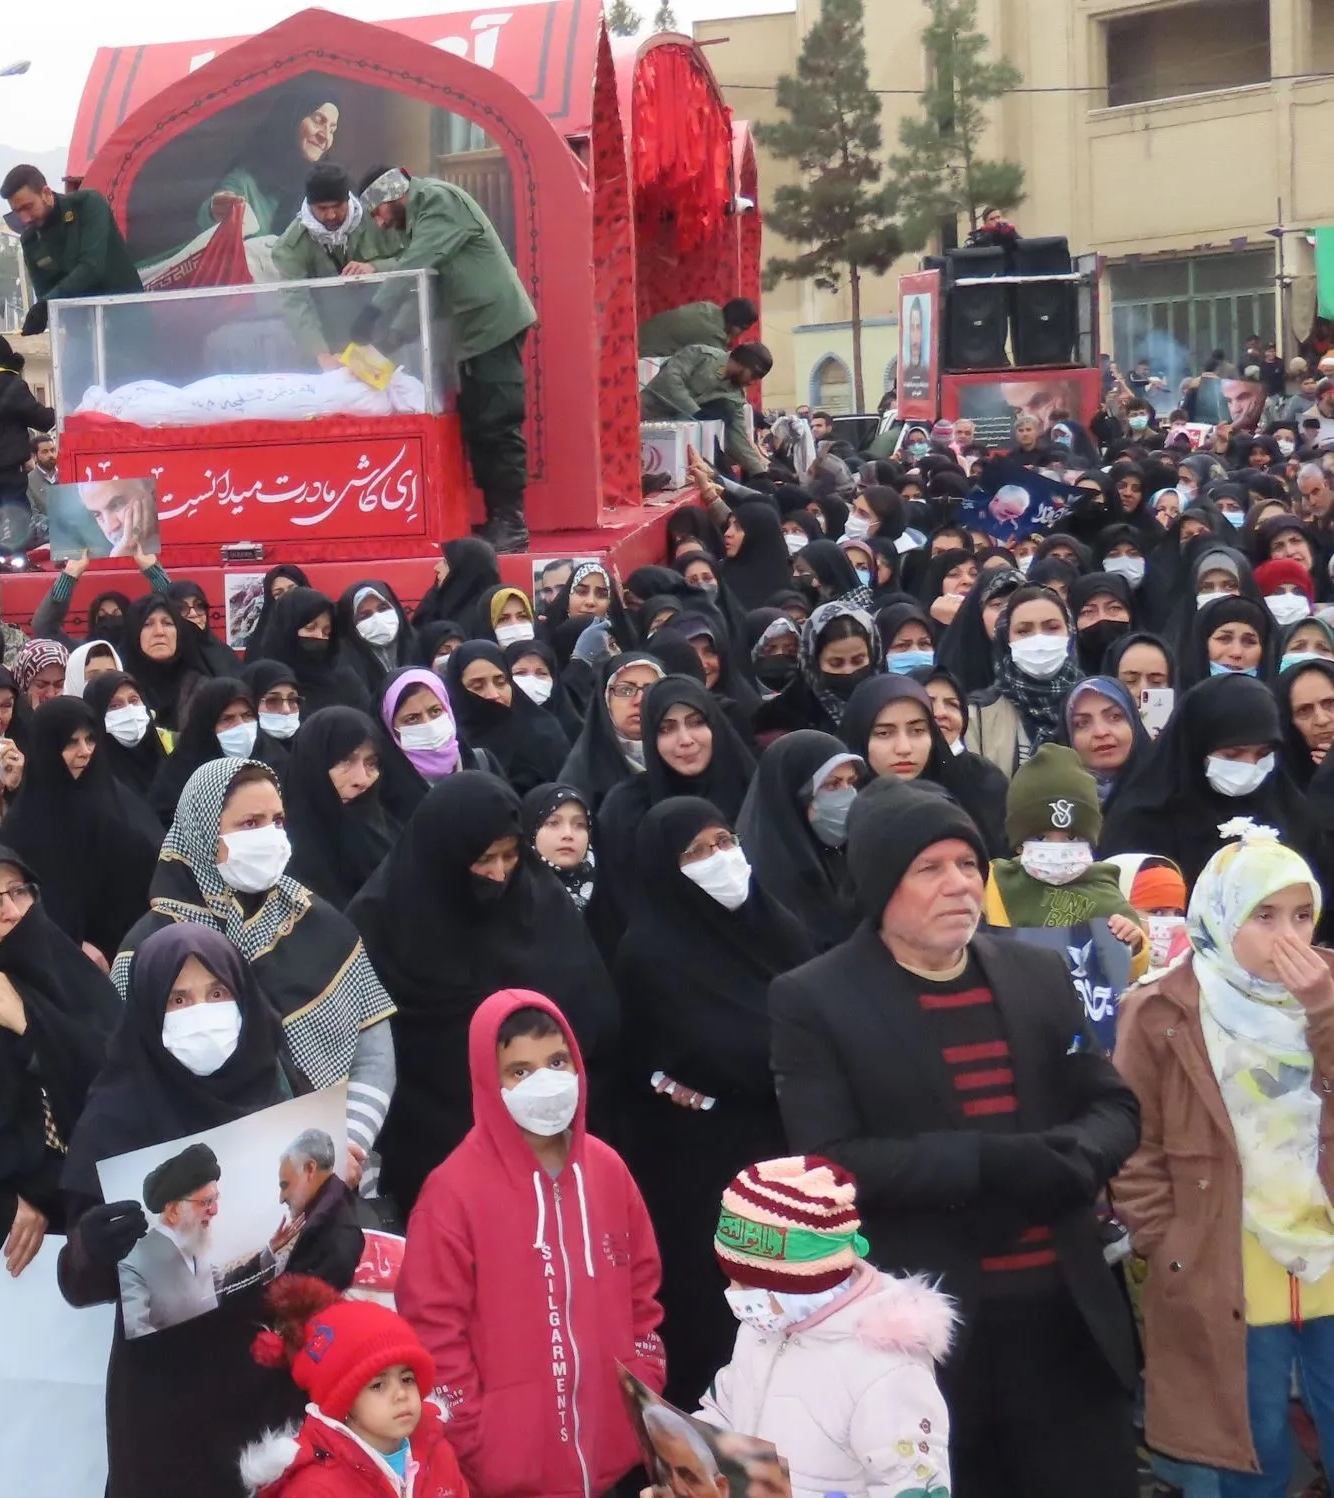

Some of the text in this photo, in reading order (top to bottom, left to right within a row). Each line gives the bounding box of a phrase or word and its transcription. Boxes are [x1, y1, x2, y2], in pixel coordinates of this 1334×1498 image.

[255, 474, 337, 504] مادرت
[289, 444, 407, 526] کاش
[541, 1244, 569, 1442] SAILGARMENTS
